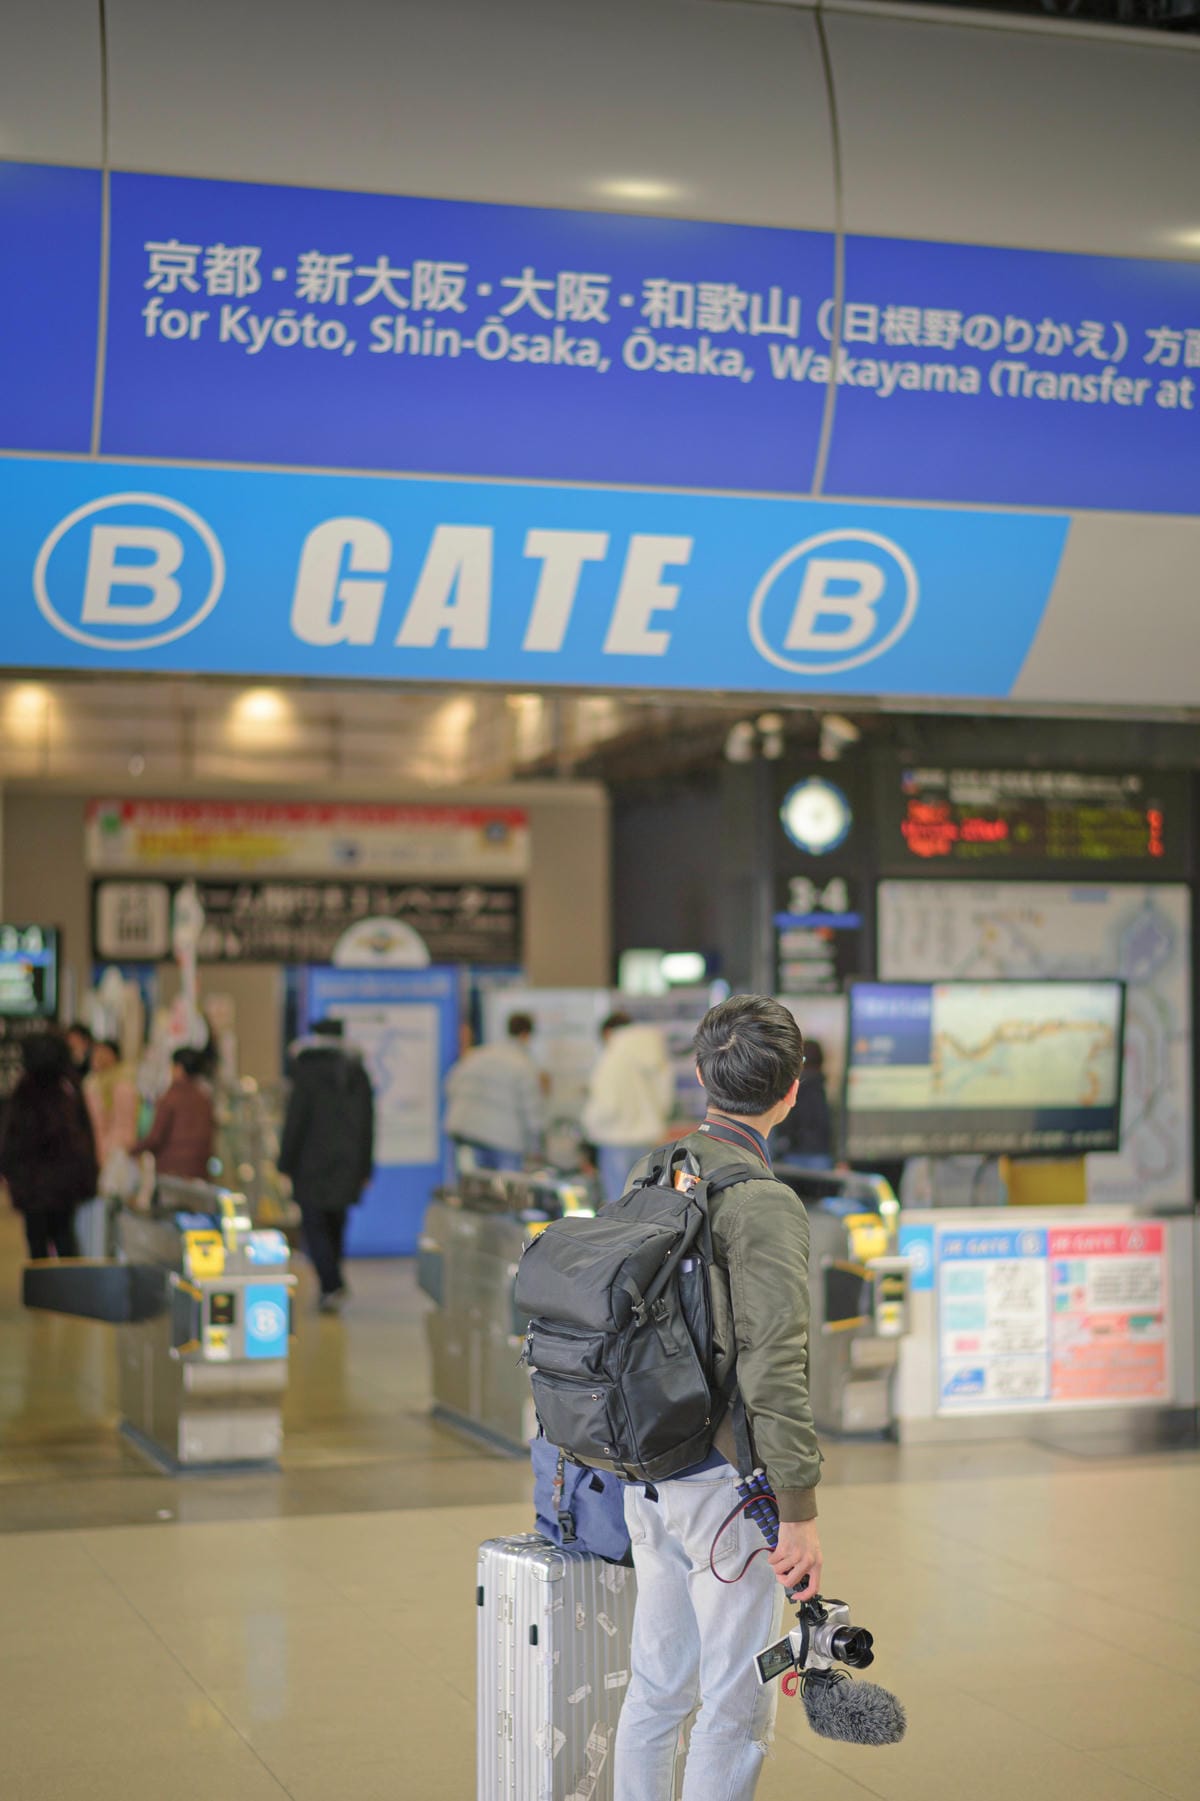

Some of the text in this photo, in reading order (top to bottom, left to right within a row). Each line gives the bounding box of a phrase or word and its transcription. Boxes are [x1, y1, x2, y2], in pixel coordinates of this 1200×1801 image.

[142, 297, 1195, 410] for Kyōto, Shin-Ōsaka, Ōsaka, Wakayama (Transfer at
[80, 516, 887, 657] B GATE B
